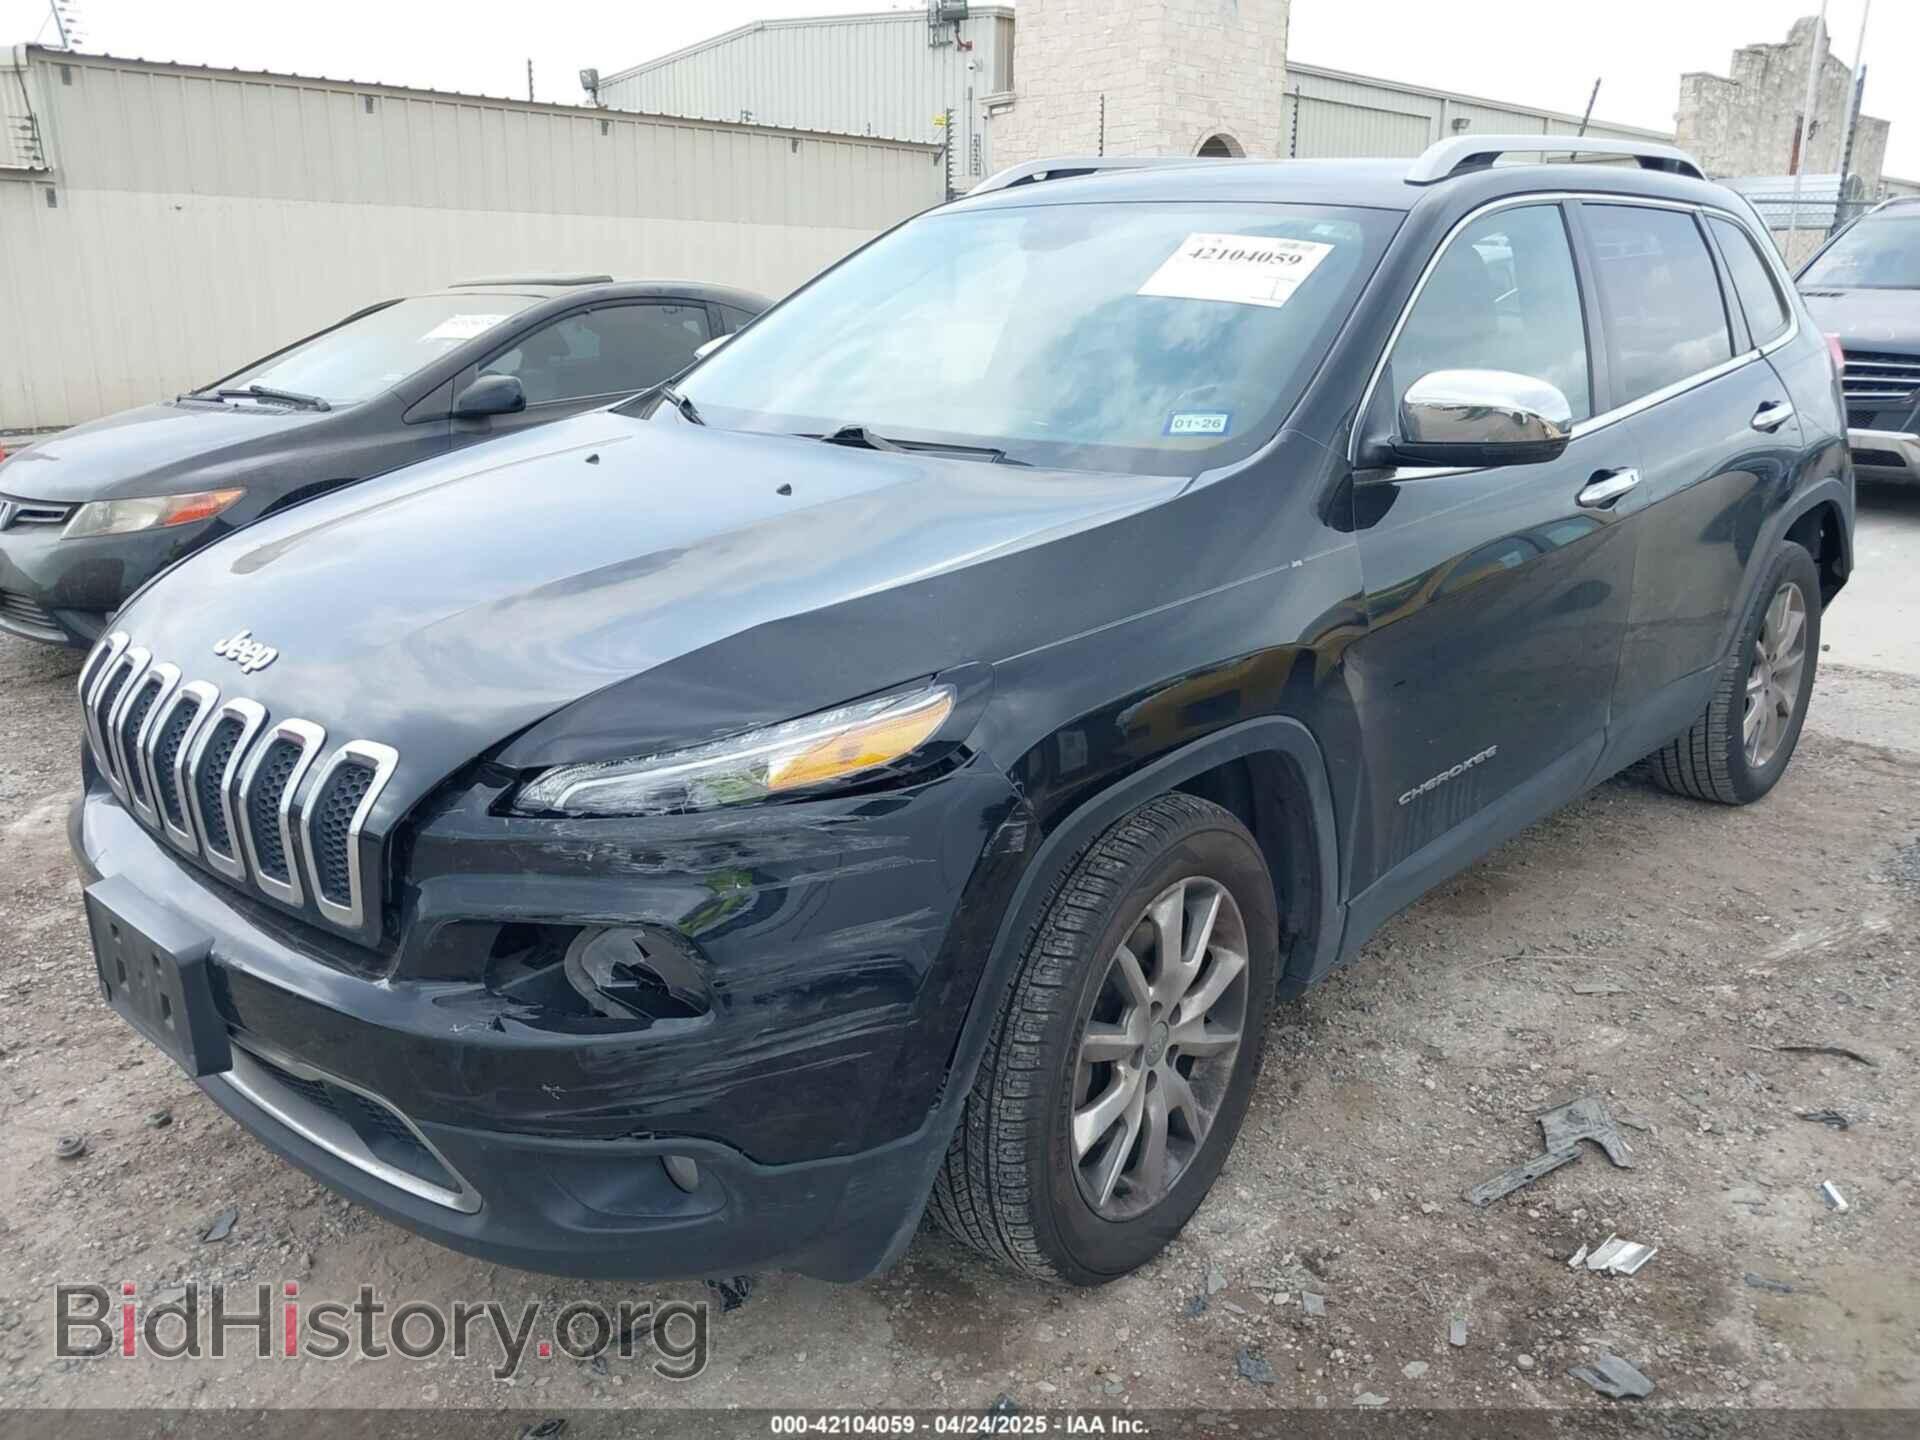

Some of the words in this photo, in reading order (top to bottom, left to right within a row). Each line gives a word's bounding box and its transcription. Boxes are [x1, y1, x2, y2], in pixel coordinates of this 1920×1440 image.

[1189, 247, 1303, 266] 42104059
[1174, 418, 1222, 429] 01-26
[213, 629, 279, 675] Jeep
[1398, 744, 1497, 806] CHEROKEE
